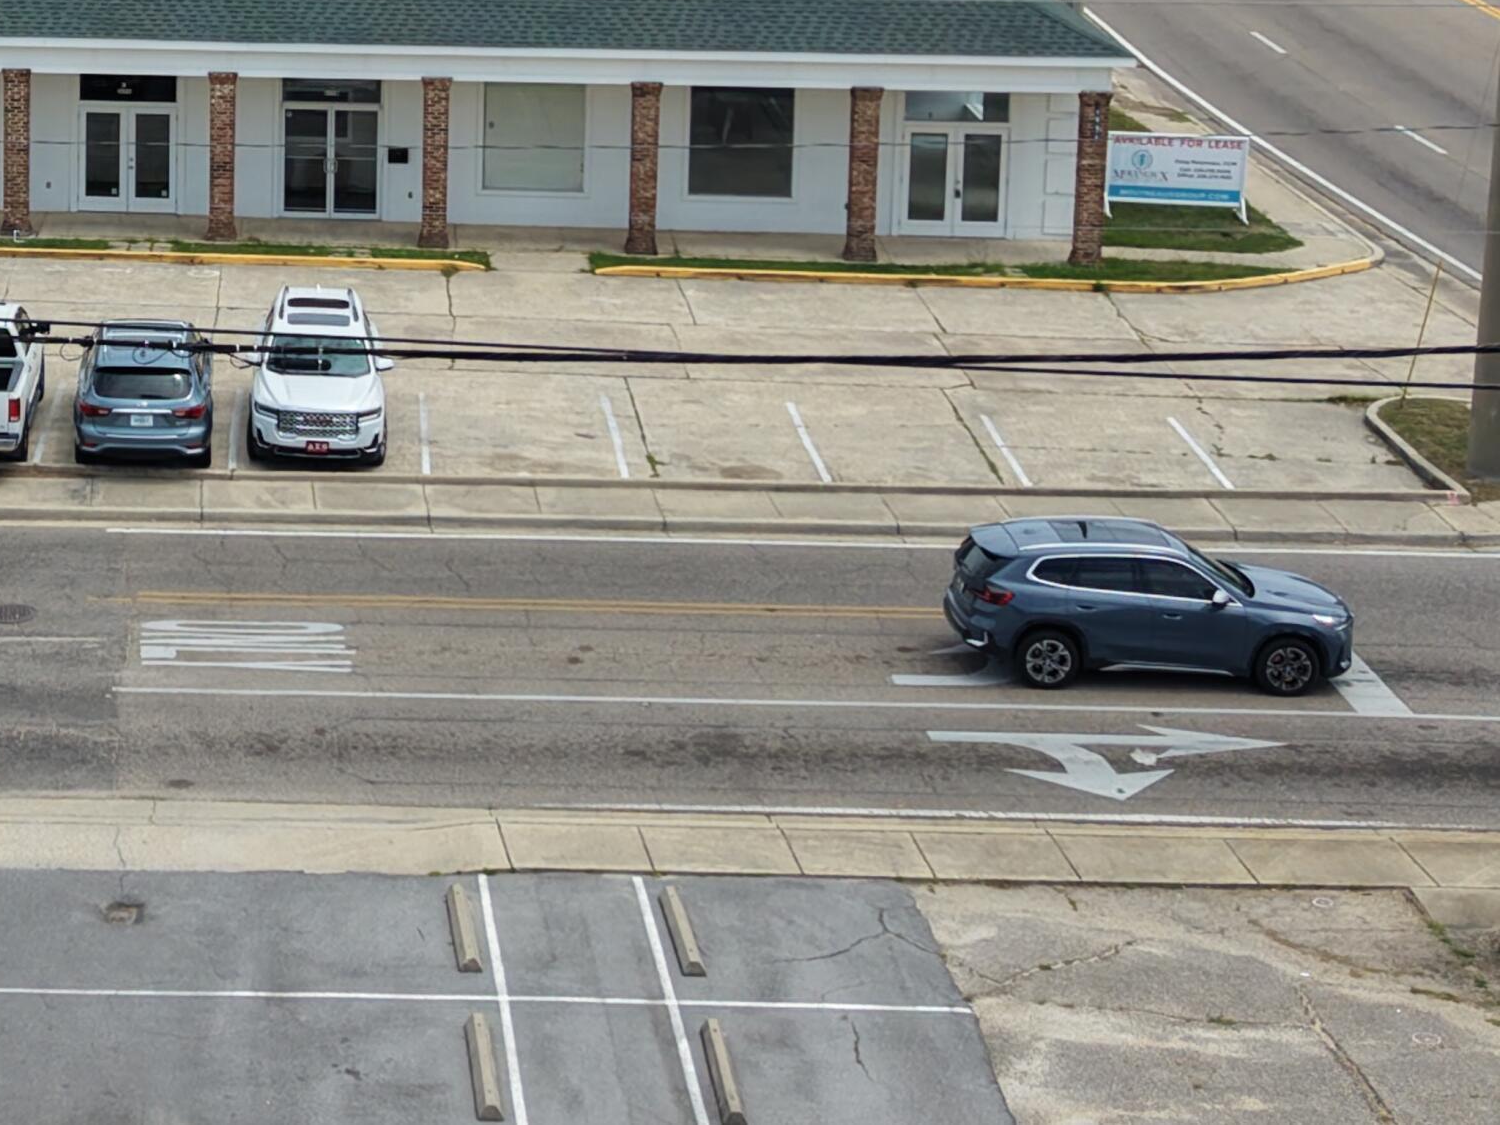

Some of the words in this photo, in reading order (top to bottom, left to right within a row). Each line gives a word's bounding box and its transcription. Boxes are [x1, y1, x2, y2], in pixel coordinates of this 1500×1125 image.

[1113, 136, 1174, 147] AVAILABLE
[1180, 138, 1203, 148] FOR
[1208, 140, 1244, 150] LEASE
